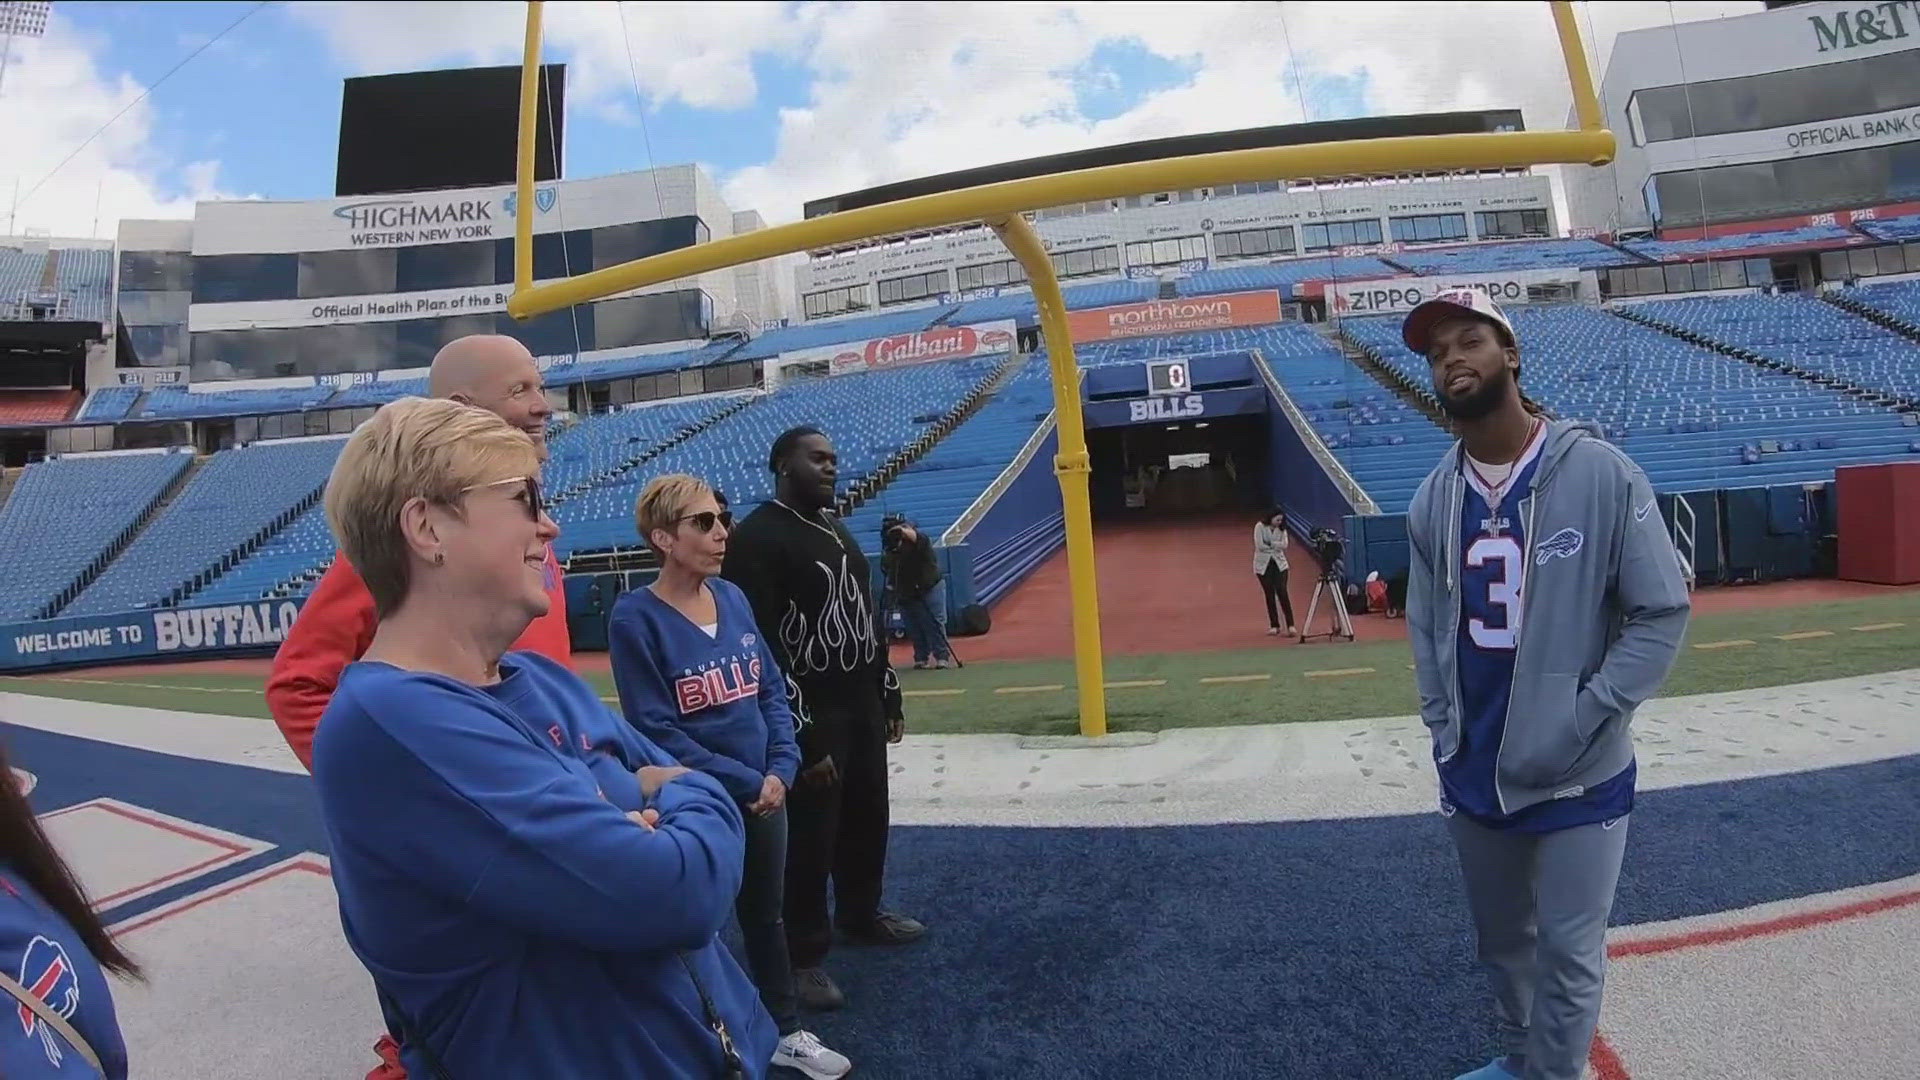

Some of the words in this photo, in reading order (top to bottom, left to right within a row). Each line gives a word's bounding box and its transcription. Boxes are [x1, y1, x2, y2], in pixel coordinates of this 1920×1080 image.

[1807, 1, 1909, 52] M&T
[1787, 124, 1860, 148] OFFICIAL
[1863, 116, 1911, 138] BANK
[351, 200, 492, 229] HIGHMARK
[351, 230, 415, 246] WESTERN
[419, 229, 452, 242] NEW
[456, 225, 493, 239] YORK
[312, 304, 363, 319] Official
[367, 299, 413, 315] Health
[416, 296, 448, 312] Plan
[450, 296, 465, 309] of
[468, 294, 491, 306] the
[1108, 301, 1232, 326] northtown
[1350, 288, 1422, 311] ZIPPO
[876, 329, 964, 366] Galbani
[1129, 395, 1204, 422] BILLS
[15, 627, 112, 654] WELCOME
[117, 624, 143, 643] TO
[153, 601, 299, 651] BUFFALO
